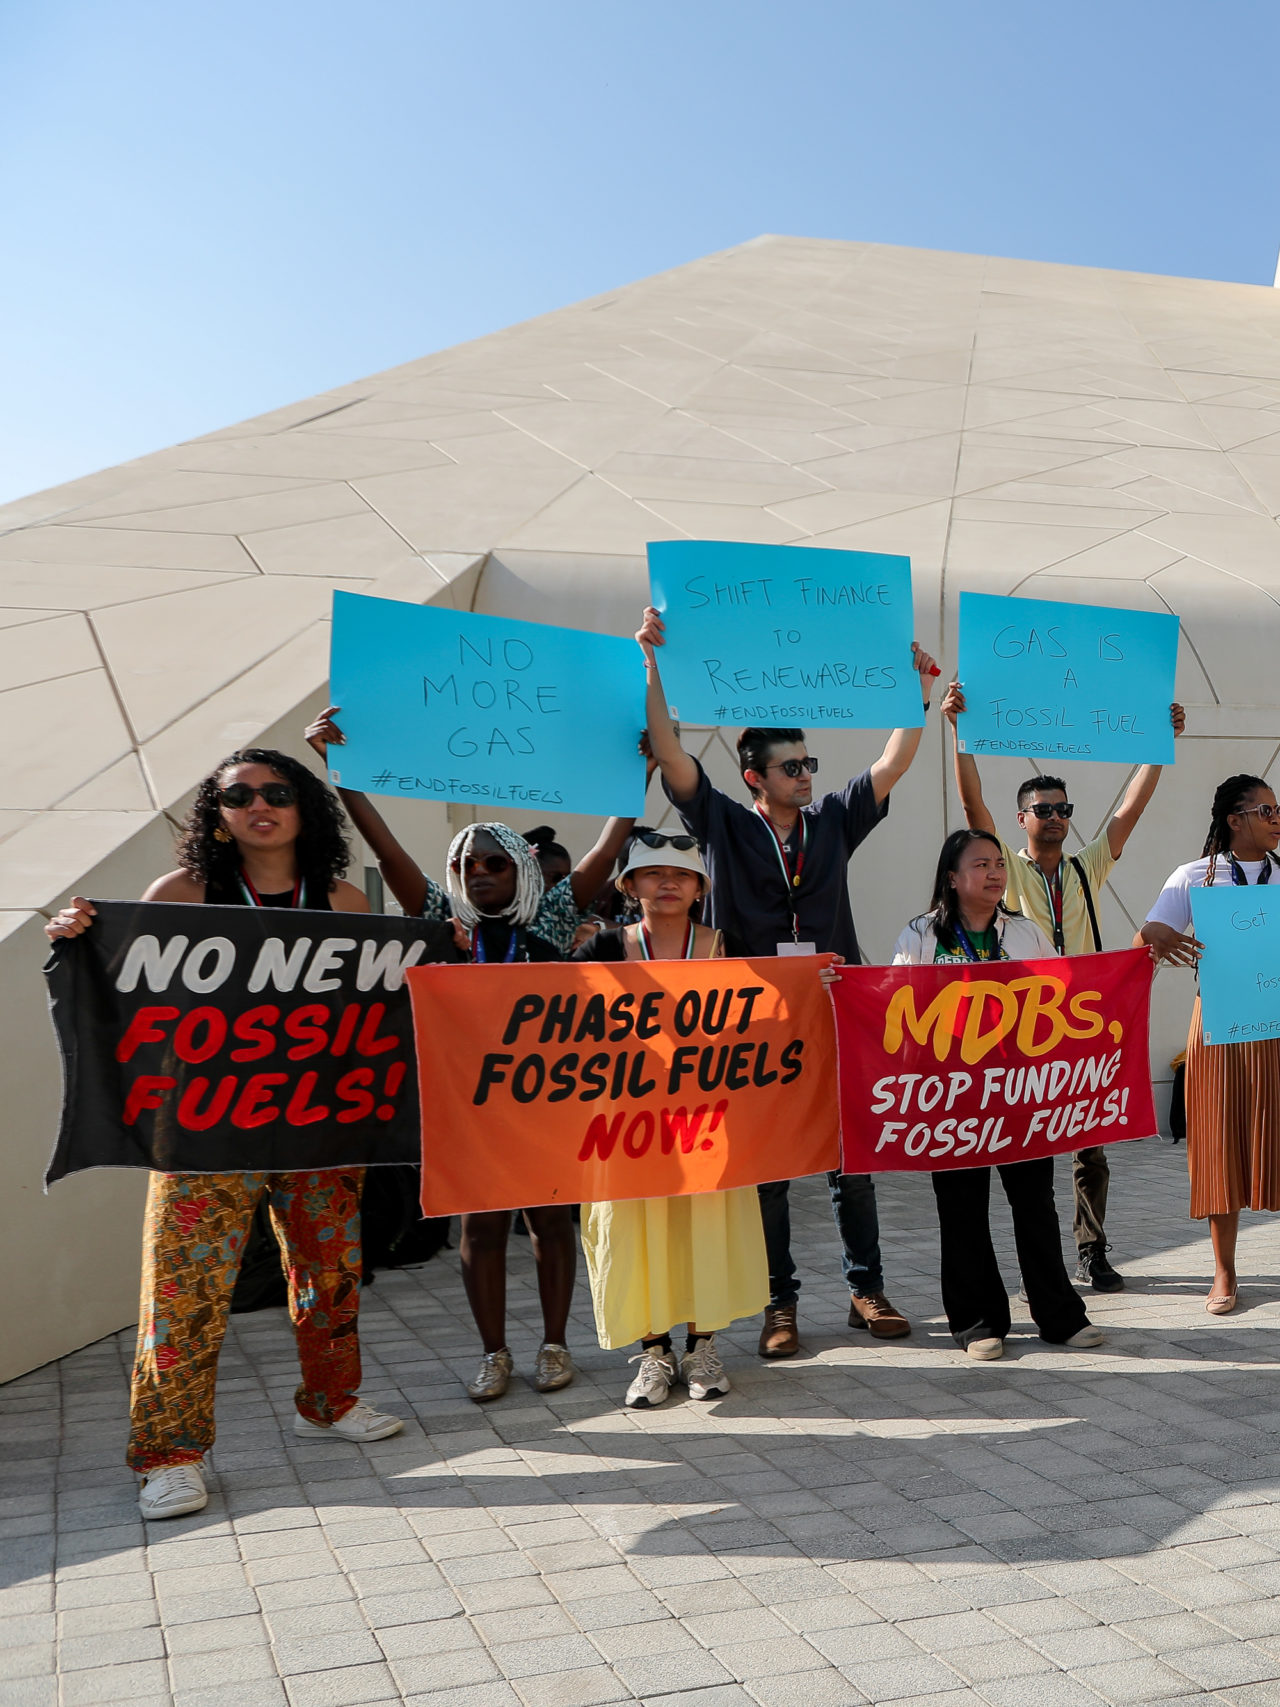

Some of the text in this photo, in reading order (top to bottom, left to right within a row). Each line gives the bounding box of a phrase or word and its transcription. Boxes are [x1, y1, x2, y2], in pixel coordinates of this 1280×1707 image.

[684, 575, 893, 609] SHIFT FINANCE
[459, 633, 534, 671] NO
[773, 629, 801, 647] TO
[993, 625, 1068, 659] GAS
[423, 673, 561, 714] MORE
[702, 659, 897, 695] RENEWABLES
[1063, 667, 1079, 689] A
[713, 704, 855, 721] #ENDFOSSILFUELS
[1089, 709, 1145, 735] FUEL
[447, 726, 535, 758] GAS
[972, 738, 1093, 755] #ENDFOSSILFUELS
[370, 768, 564, 804] #ENDFOSSILFUELS
[1231, 907, 1269, 931] Get
[115, 934, 427, 994] NO NEW
[116, 1002, 400, 1064] FOSSIL
[501, 986, 765, 1046] PHASE OUT
[883, 974, 1124, 1066] MDBs,
[472, 1039, 804, 1106] FOSSIL FUELS
[870, 1048, 1123, 1115] STOP FUNDING
[122, 1061, 407, 1132] FUELS!
[577, 1098, 730, 1162] NOW!
[874, 1087, 1130, 1157] FOSSIL FUELS!
